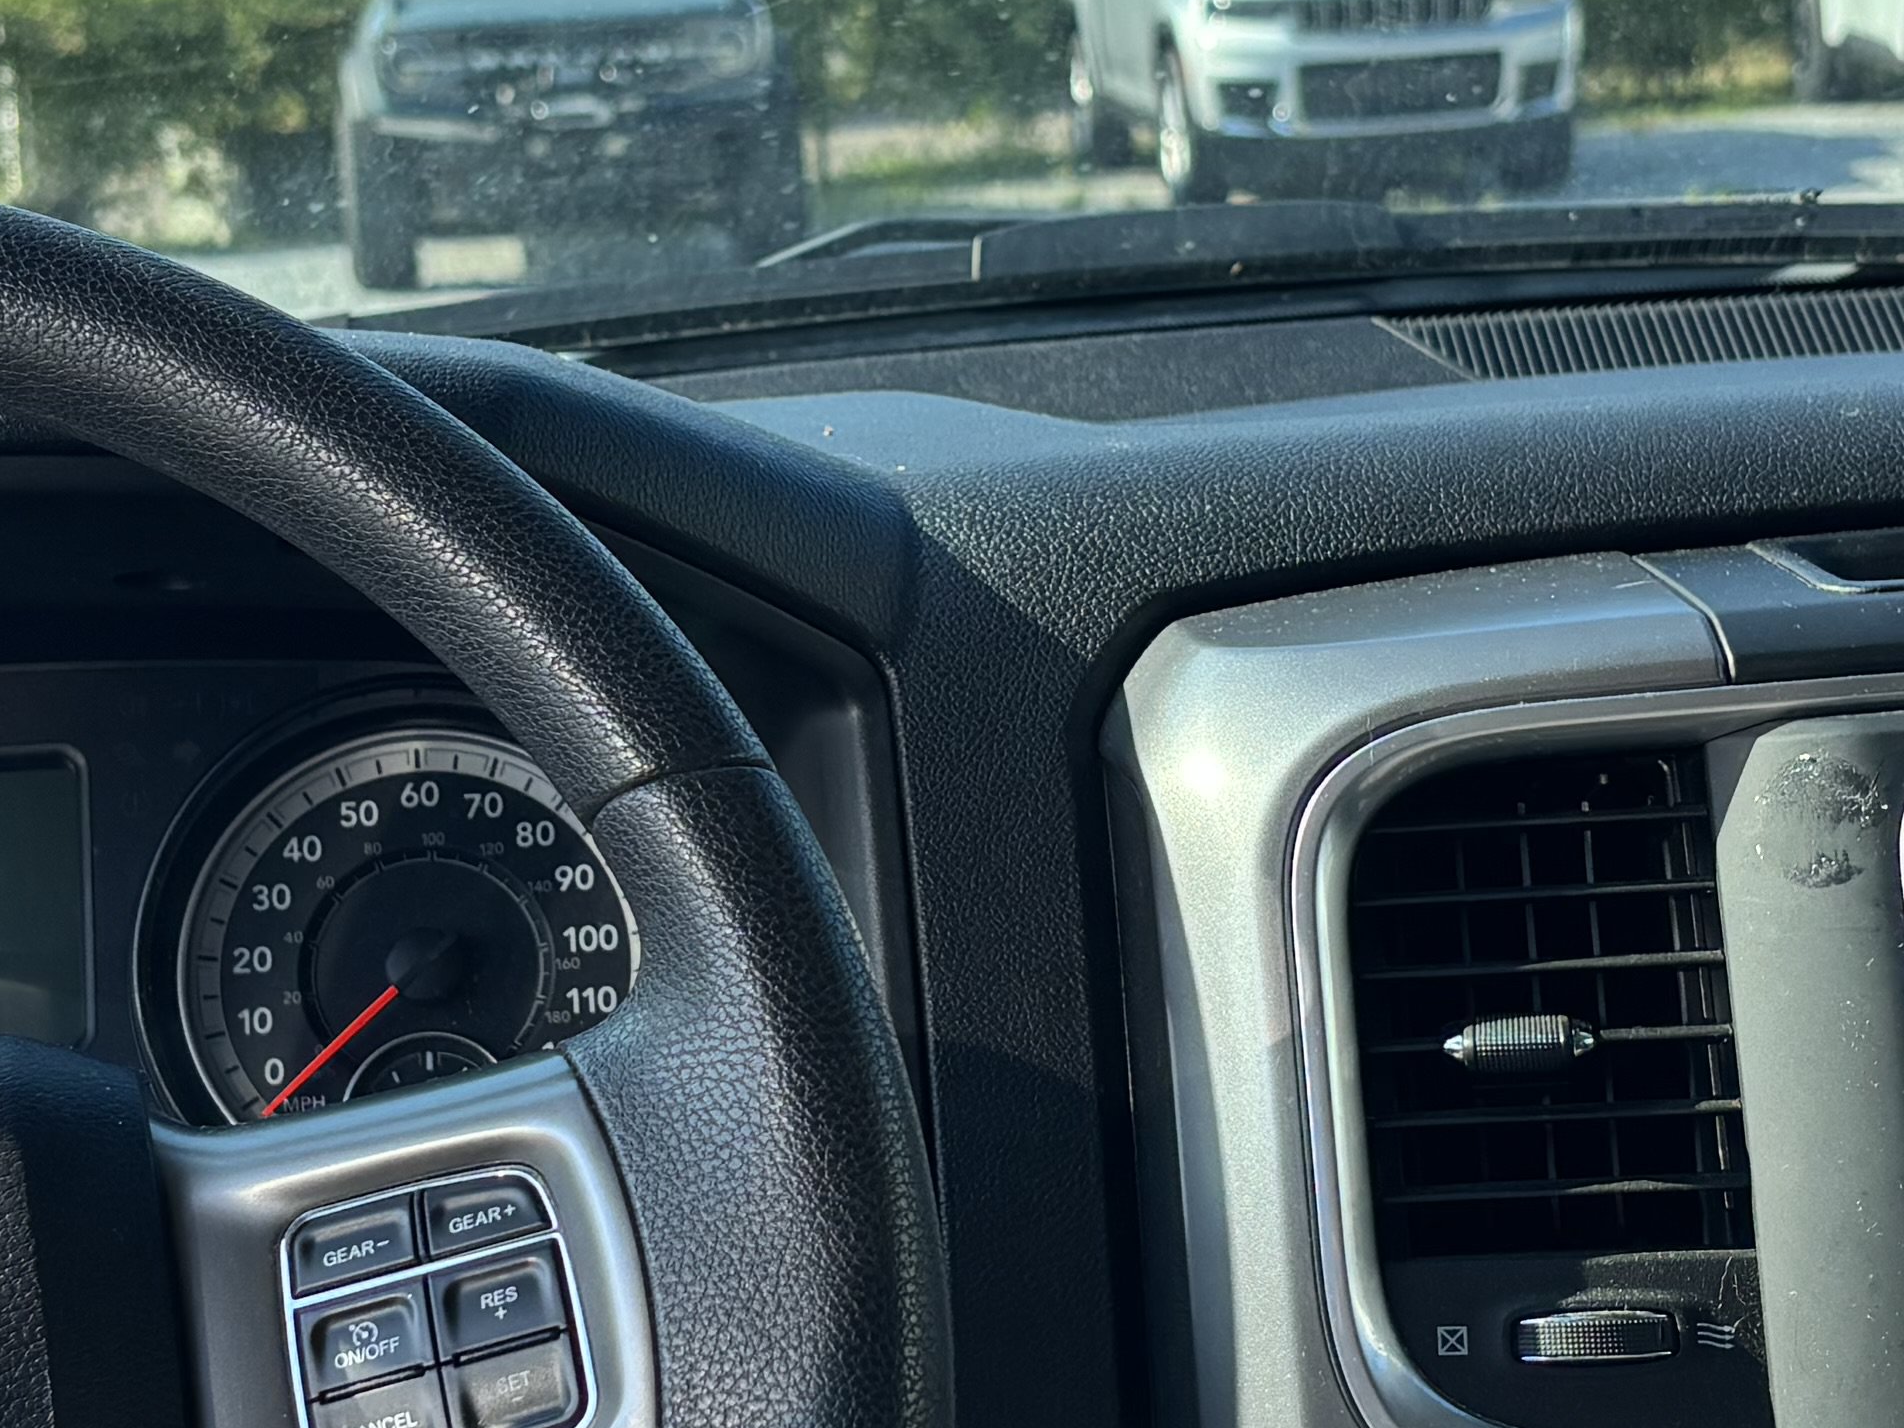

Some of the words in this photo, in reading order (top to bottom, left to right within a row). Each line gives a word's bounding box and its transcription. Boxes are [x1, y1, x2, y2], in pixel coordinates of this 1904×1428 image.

[401, 782, 440, 808] 60
[464, 792, 503, 819] 70
[340, 801, 379, 827] 50
[421, 832, 445, 847] 100
[516, 821, 555, 848] 80
[283, 836, 322, 862] 40
[364, 842, 382, 856] 80
[480, 841, 504, 856] 120
[316, 875, 335, 889] 60
[554, 864, 594, 891] 90
[252, 884, 291, 910] 30
[284, 931, 304, 945] 40
[563, 925, 618, 952] 100
[233, 946, 272, 974] 20
[555, 957, 581, 971] 160
[283, 991, 302, 1005] 20
[566, 987, 618, 1013] 110
[238, 1008, 273, 1034] 10
[546, 1010, 571, 1024] 180
[264, 1059, 284, 1085] 0
[283, 1095, 326, 1113] MPH
[480, 1285, 518, 1309] RES
[334, 1336, 400, 1369] ON/OFF
[497, 1370, 531, 1395] SET
